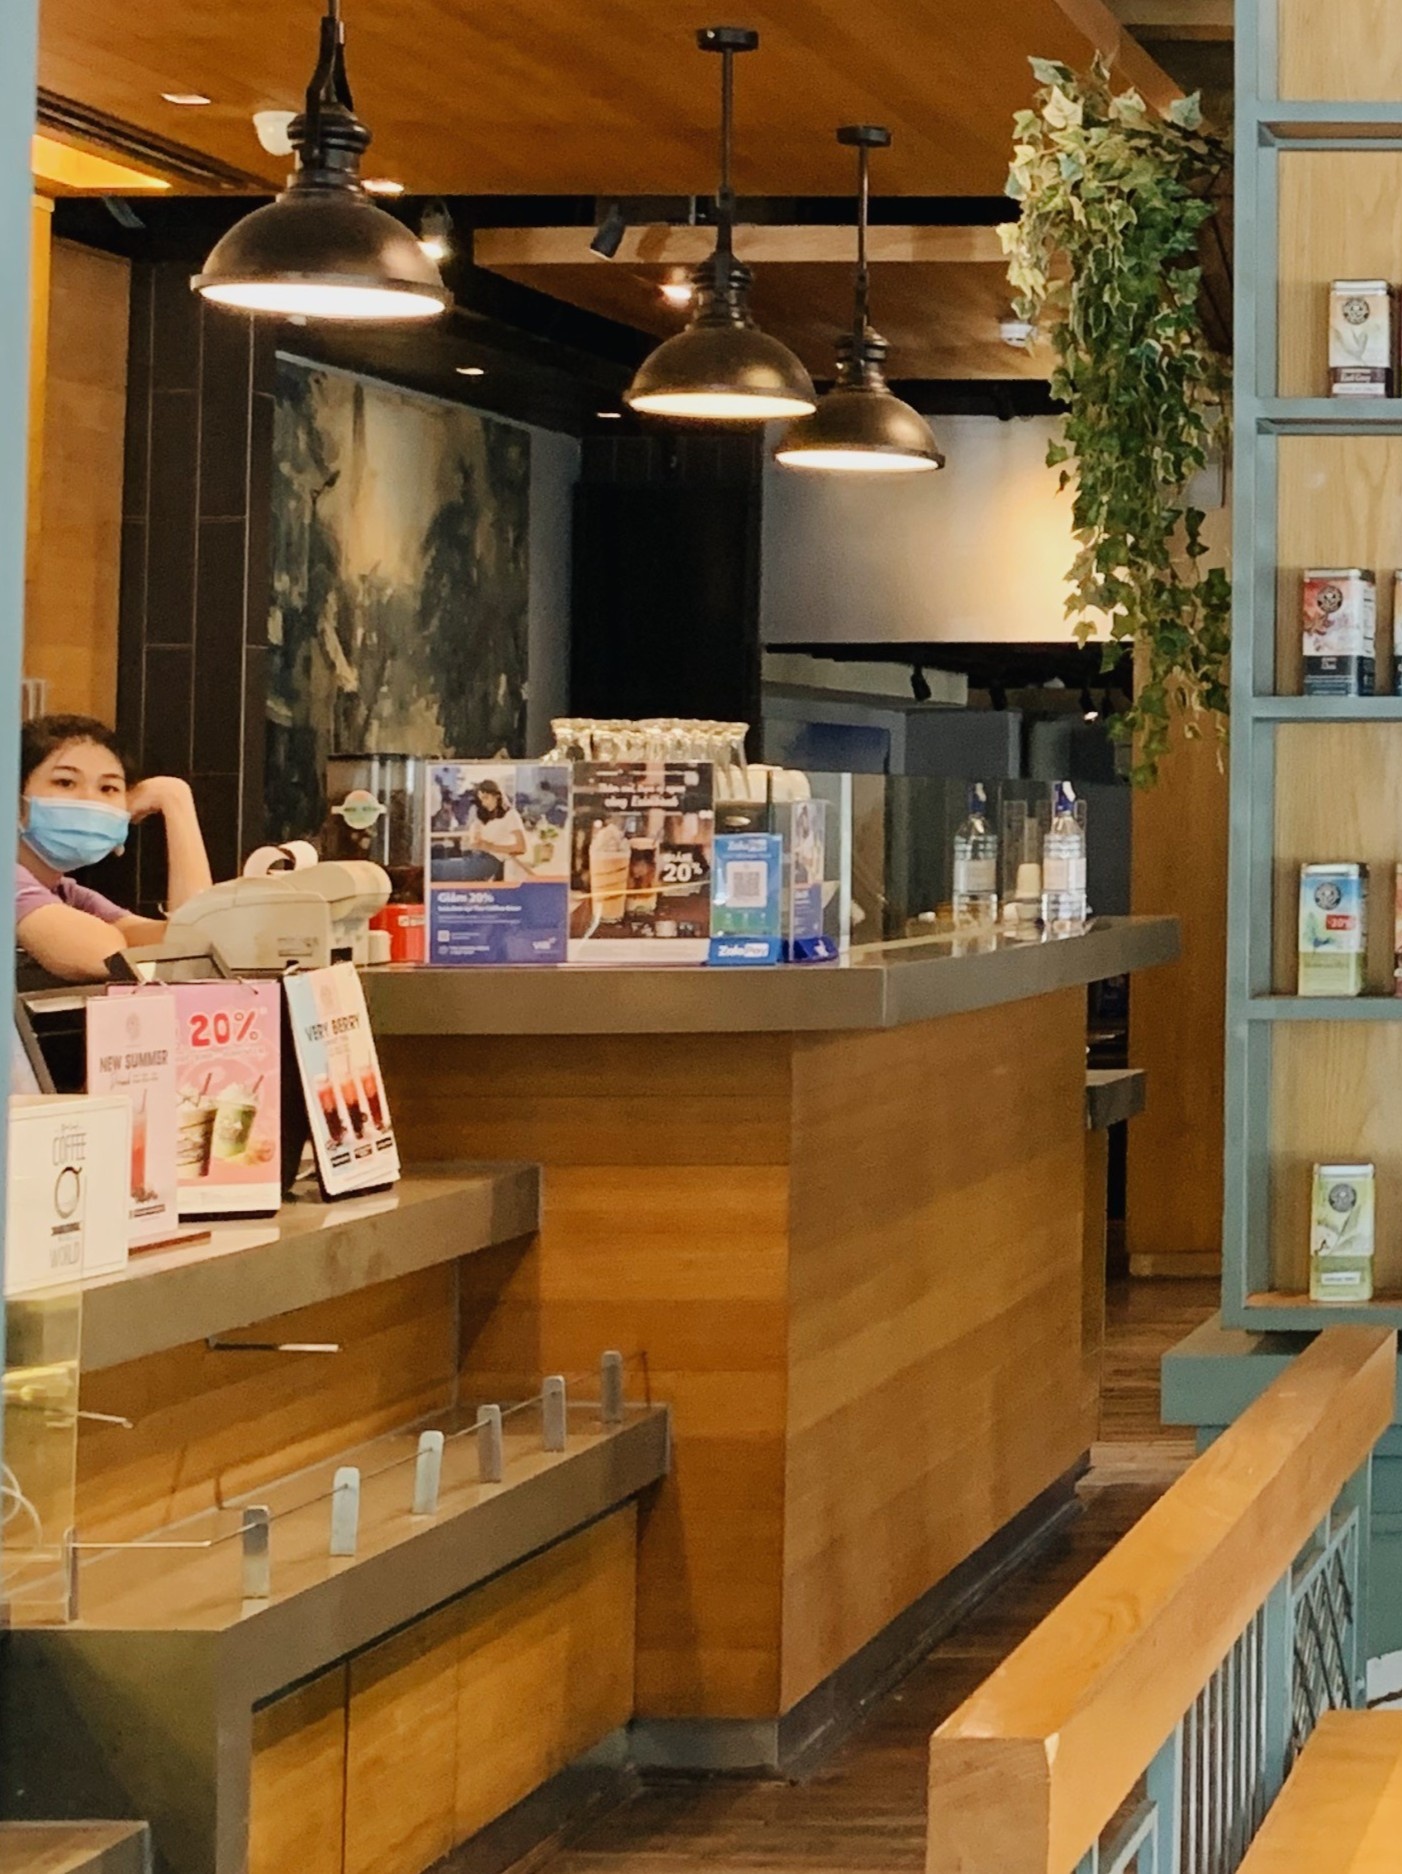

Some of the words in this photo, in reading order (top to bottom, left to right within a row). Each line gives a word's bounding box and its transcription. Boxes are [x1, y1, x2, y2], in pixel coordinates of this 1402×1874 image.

[662, 862, 703, 882] 20%
[189, 1010, 260, 1048] 20%
[304, 1022, 328, 1042] VERY
[331, 1013, 360, 1035] BERRY
[99, 1055, 122, 1073] NEW
[125, 1049, 168, 1069] SUMMER
[52, 1132, 86, 1166] COFFEE
